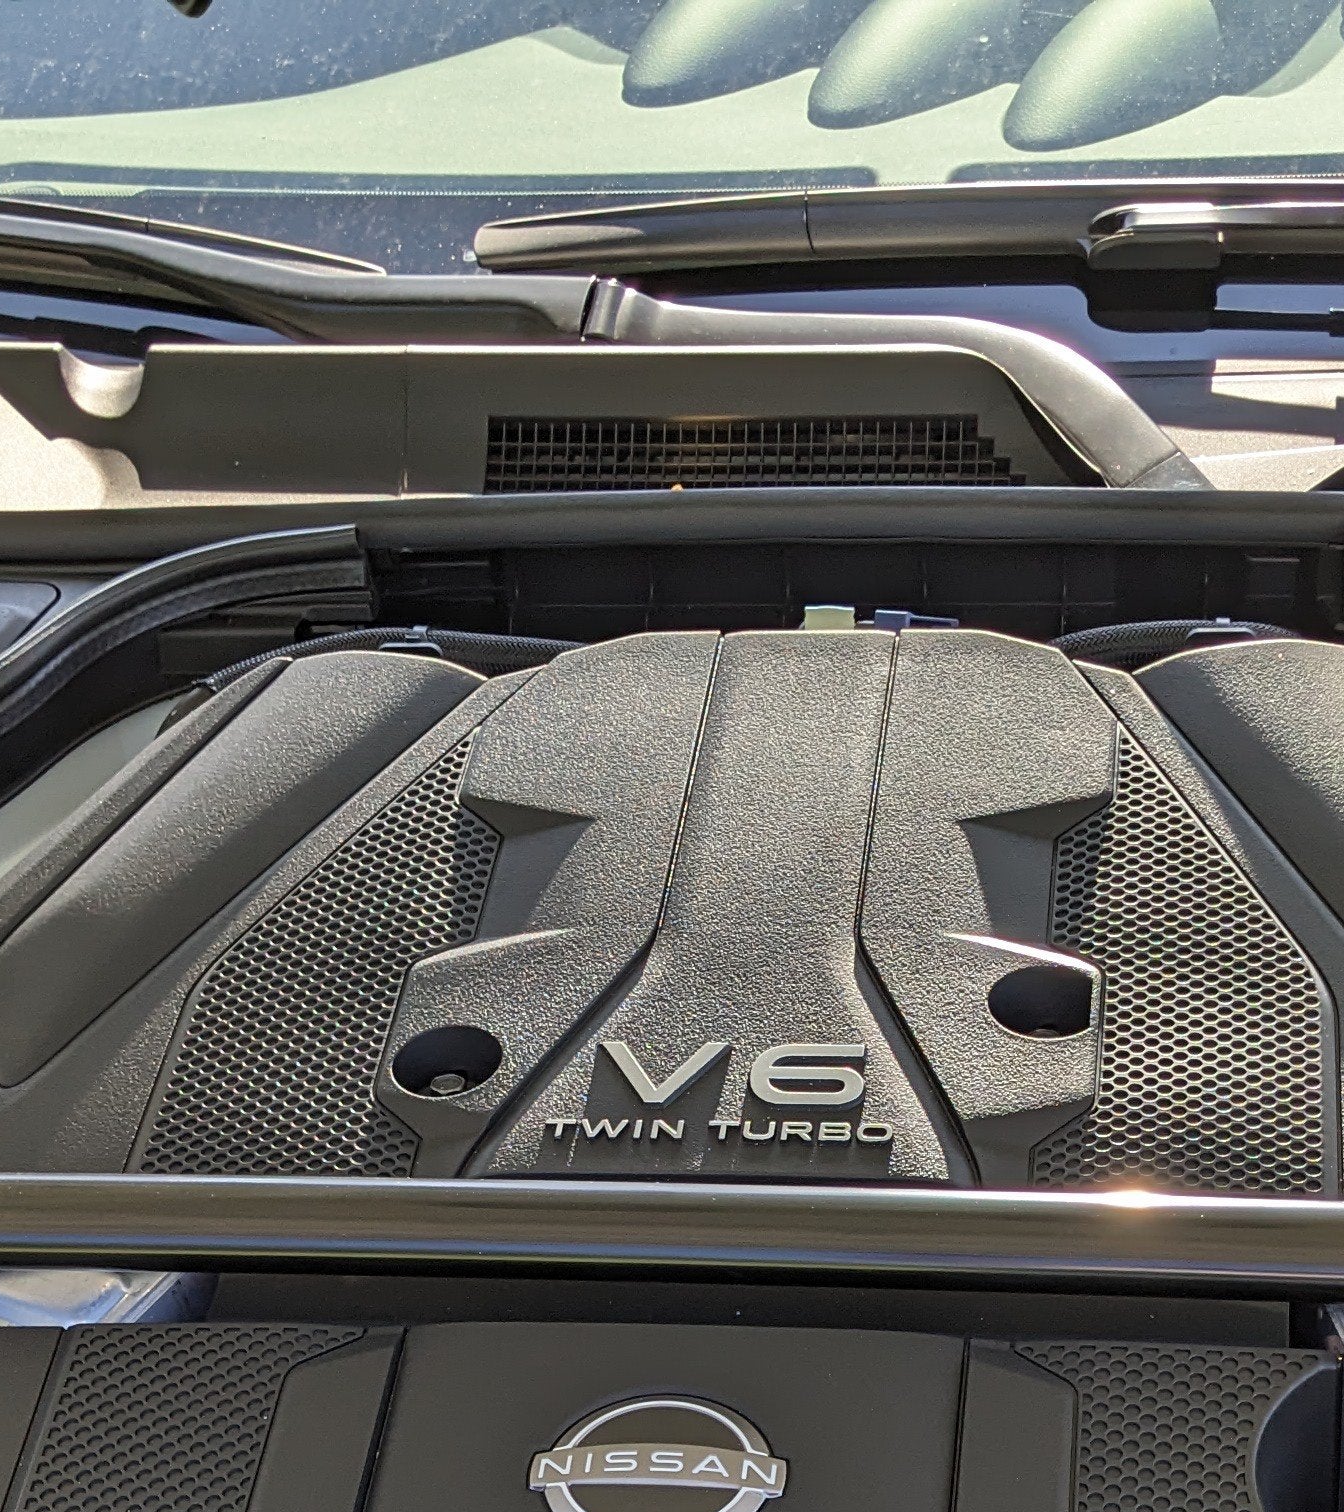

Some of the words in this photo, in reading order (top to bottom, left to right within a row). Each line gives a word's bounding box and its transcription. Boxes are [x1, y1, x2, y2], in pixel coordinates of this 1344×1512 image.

[597, 1041, 866, 1107] V6
[545, 1118, 686, 1141] TWIN
[708, 1119, 894, 1143] TURBO
[537, 1451, 778, 1485] NISSAN
